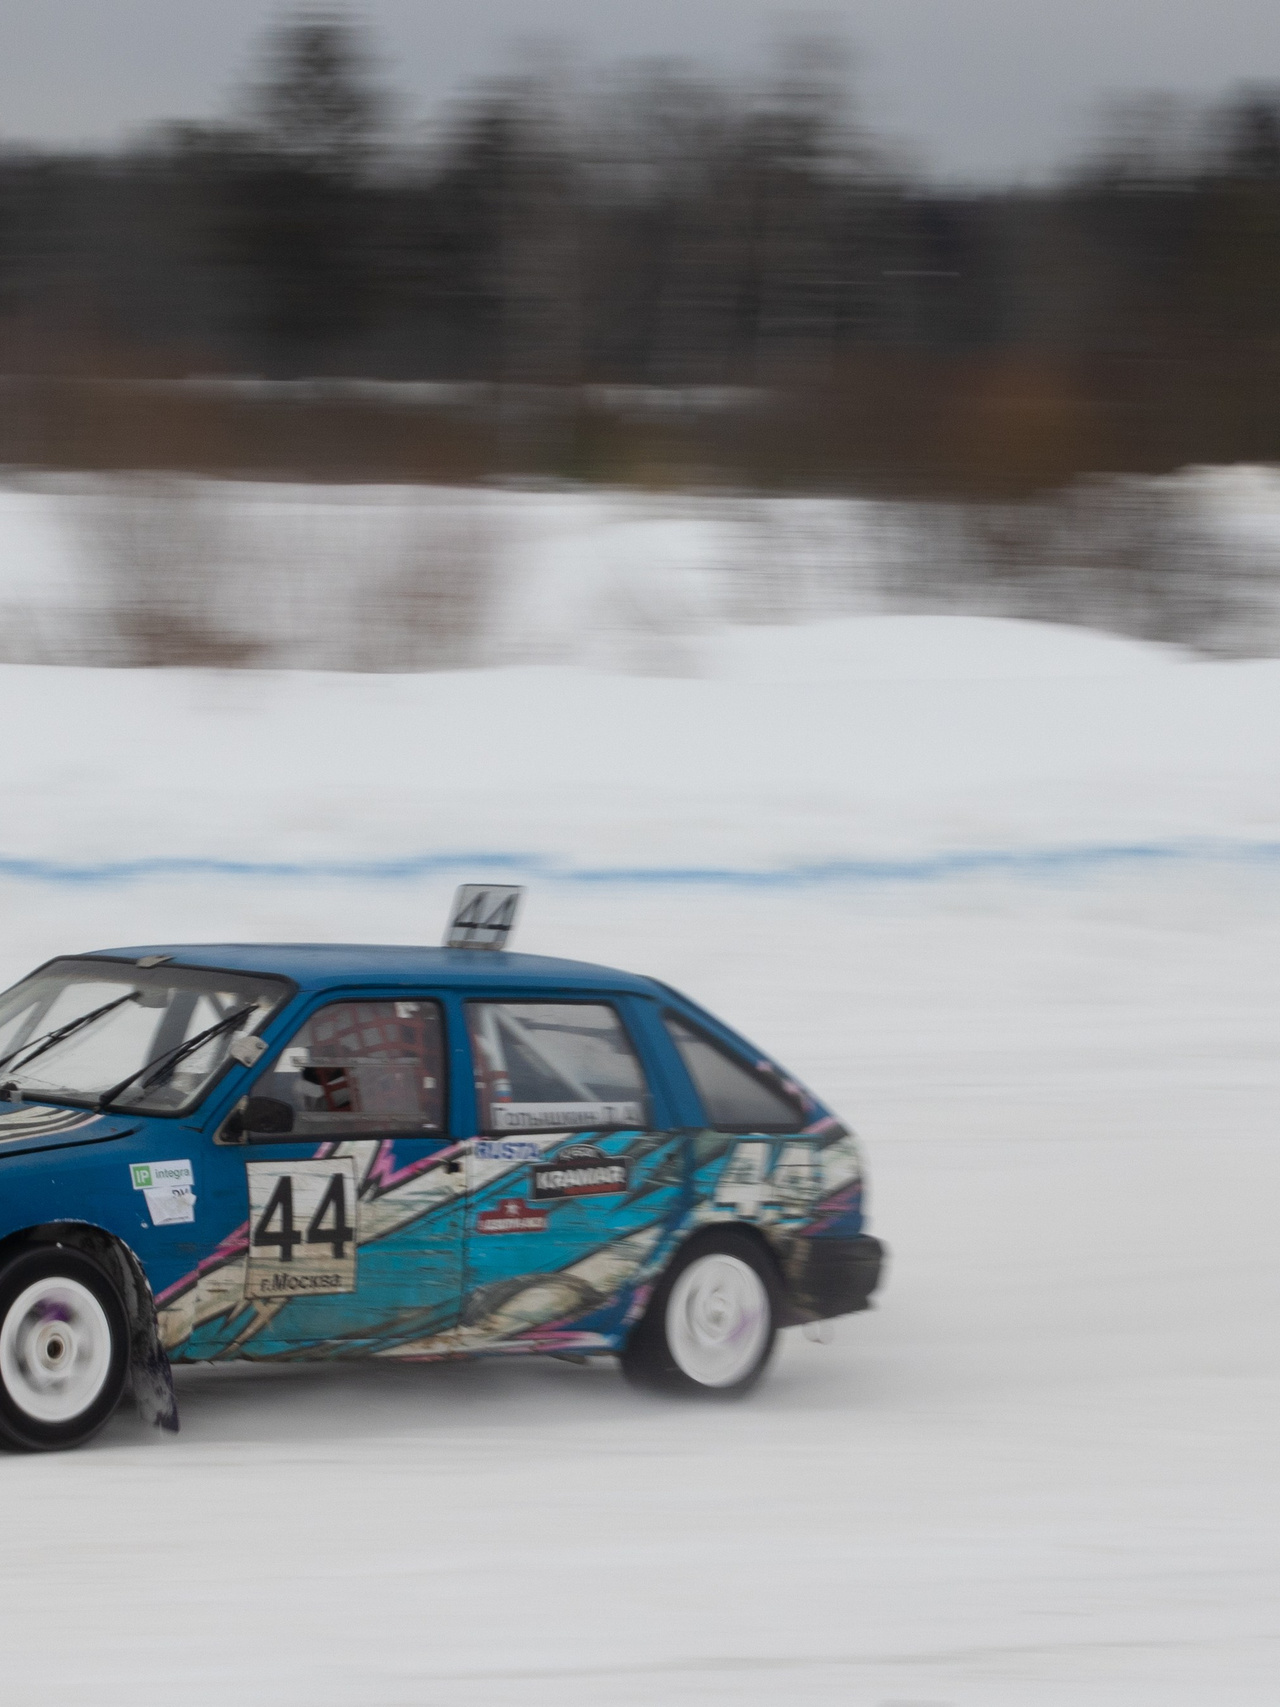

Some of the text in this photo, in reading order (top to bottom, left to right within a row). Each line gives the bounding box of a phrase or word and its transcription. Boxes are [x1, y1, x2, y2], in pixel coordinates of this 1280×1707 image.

[452, 891, 519, 941] 44
[155, 1168, 190, 1180] integra
[535, 1166, 628, 1190] KRAMAR
[253, 1173, 353, 1262] 44
